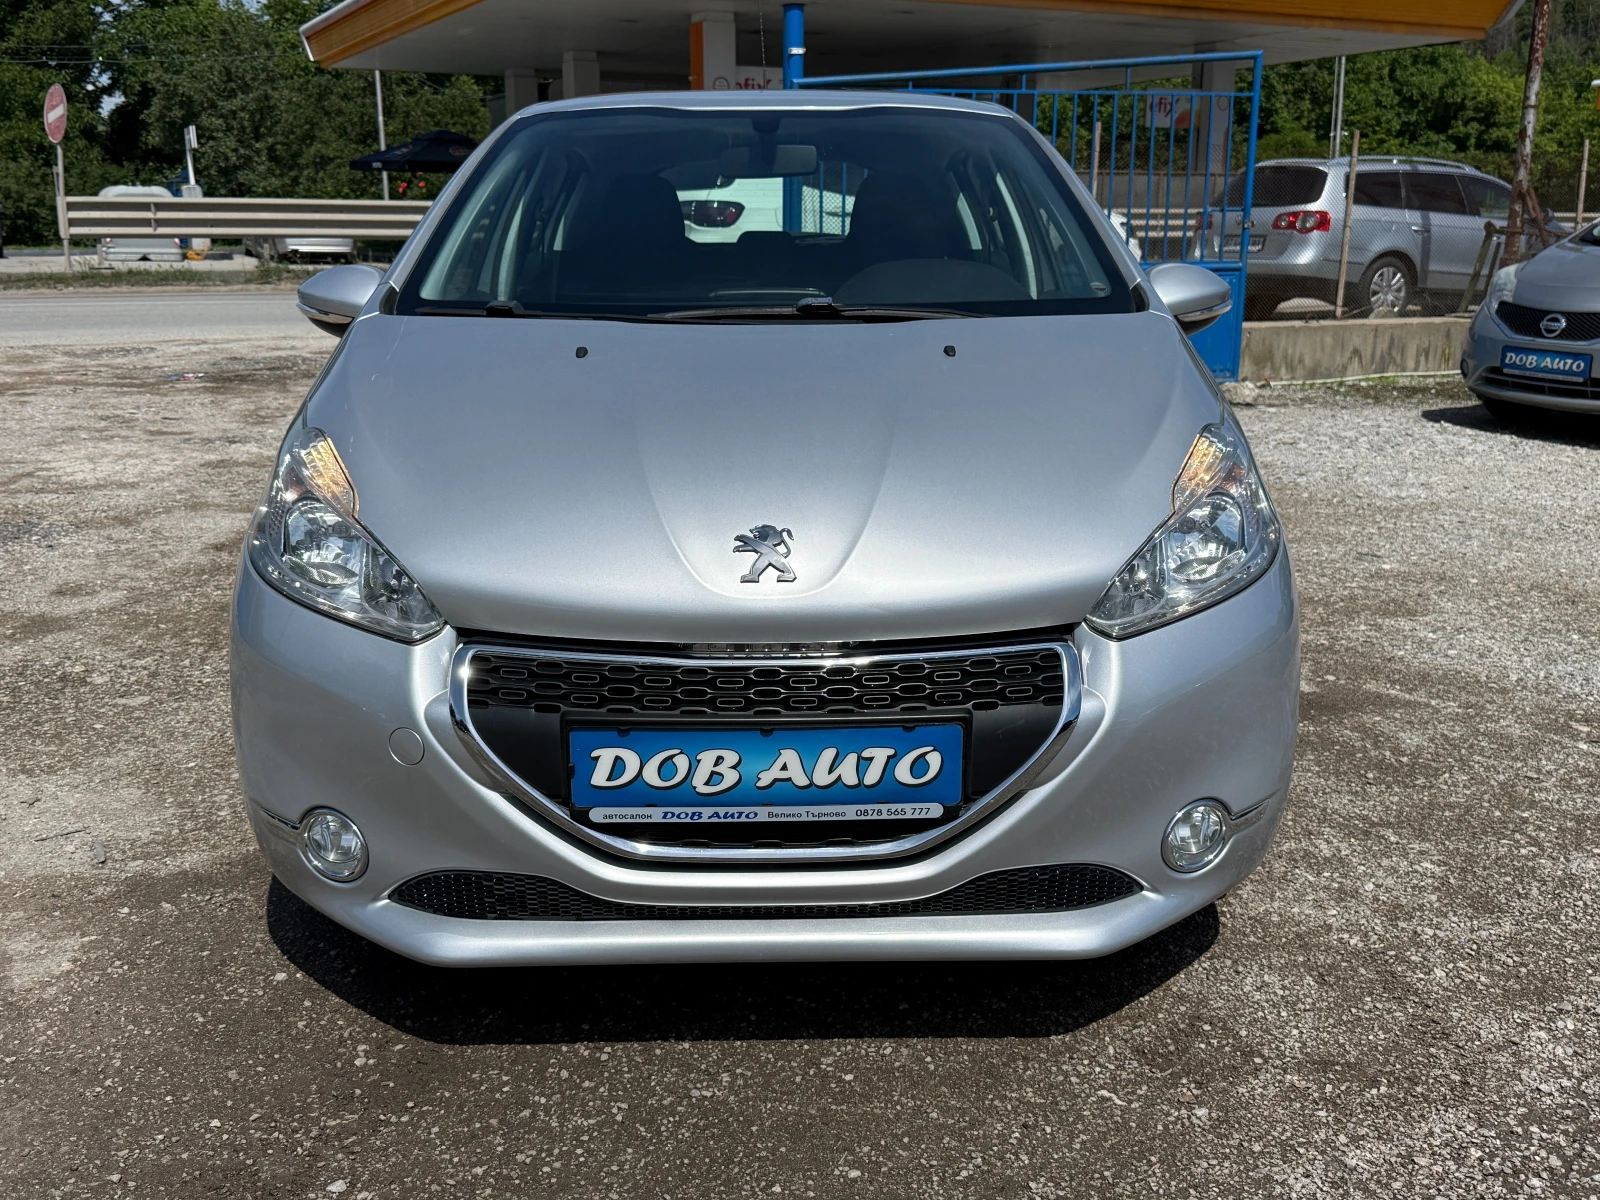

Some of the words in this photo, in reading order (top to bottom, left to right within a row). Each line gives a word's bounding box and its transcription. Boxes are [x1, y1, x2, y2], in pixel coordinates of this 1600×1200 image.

[1504, 352, 1537, 369] DOB
[1540, 357, 1585, 372] AUTO
[590, 746, 742, 797] DOB
[754, 746, 944, 791] AUTO
[602, 812, 653, 820] автосалон
[661, 811, 704, 821] DOB
[707, 811, 759, 820] AUTO
[767, 811, 802, 819] Велико
[805, 810, 847, 819] Търново
[855, 808, 883, 817] 0878
[886, 808, 907, 816] 565
[910, 807, 931, 815] 777
